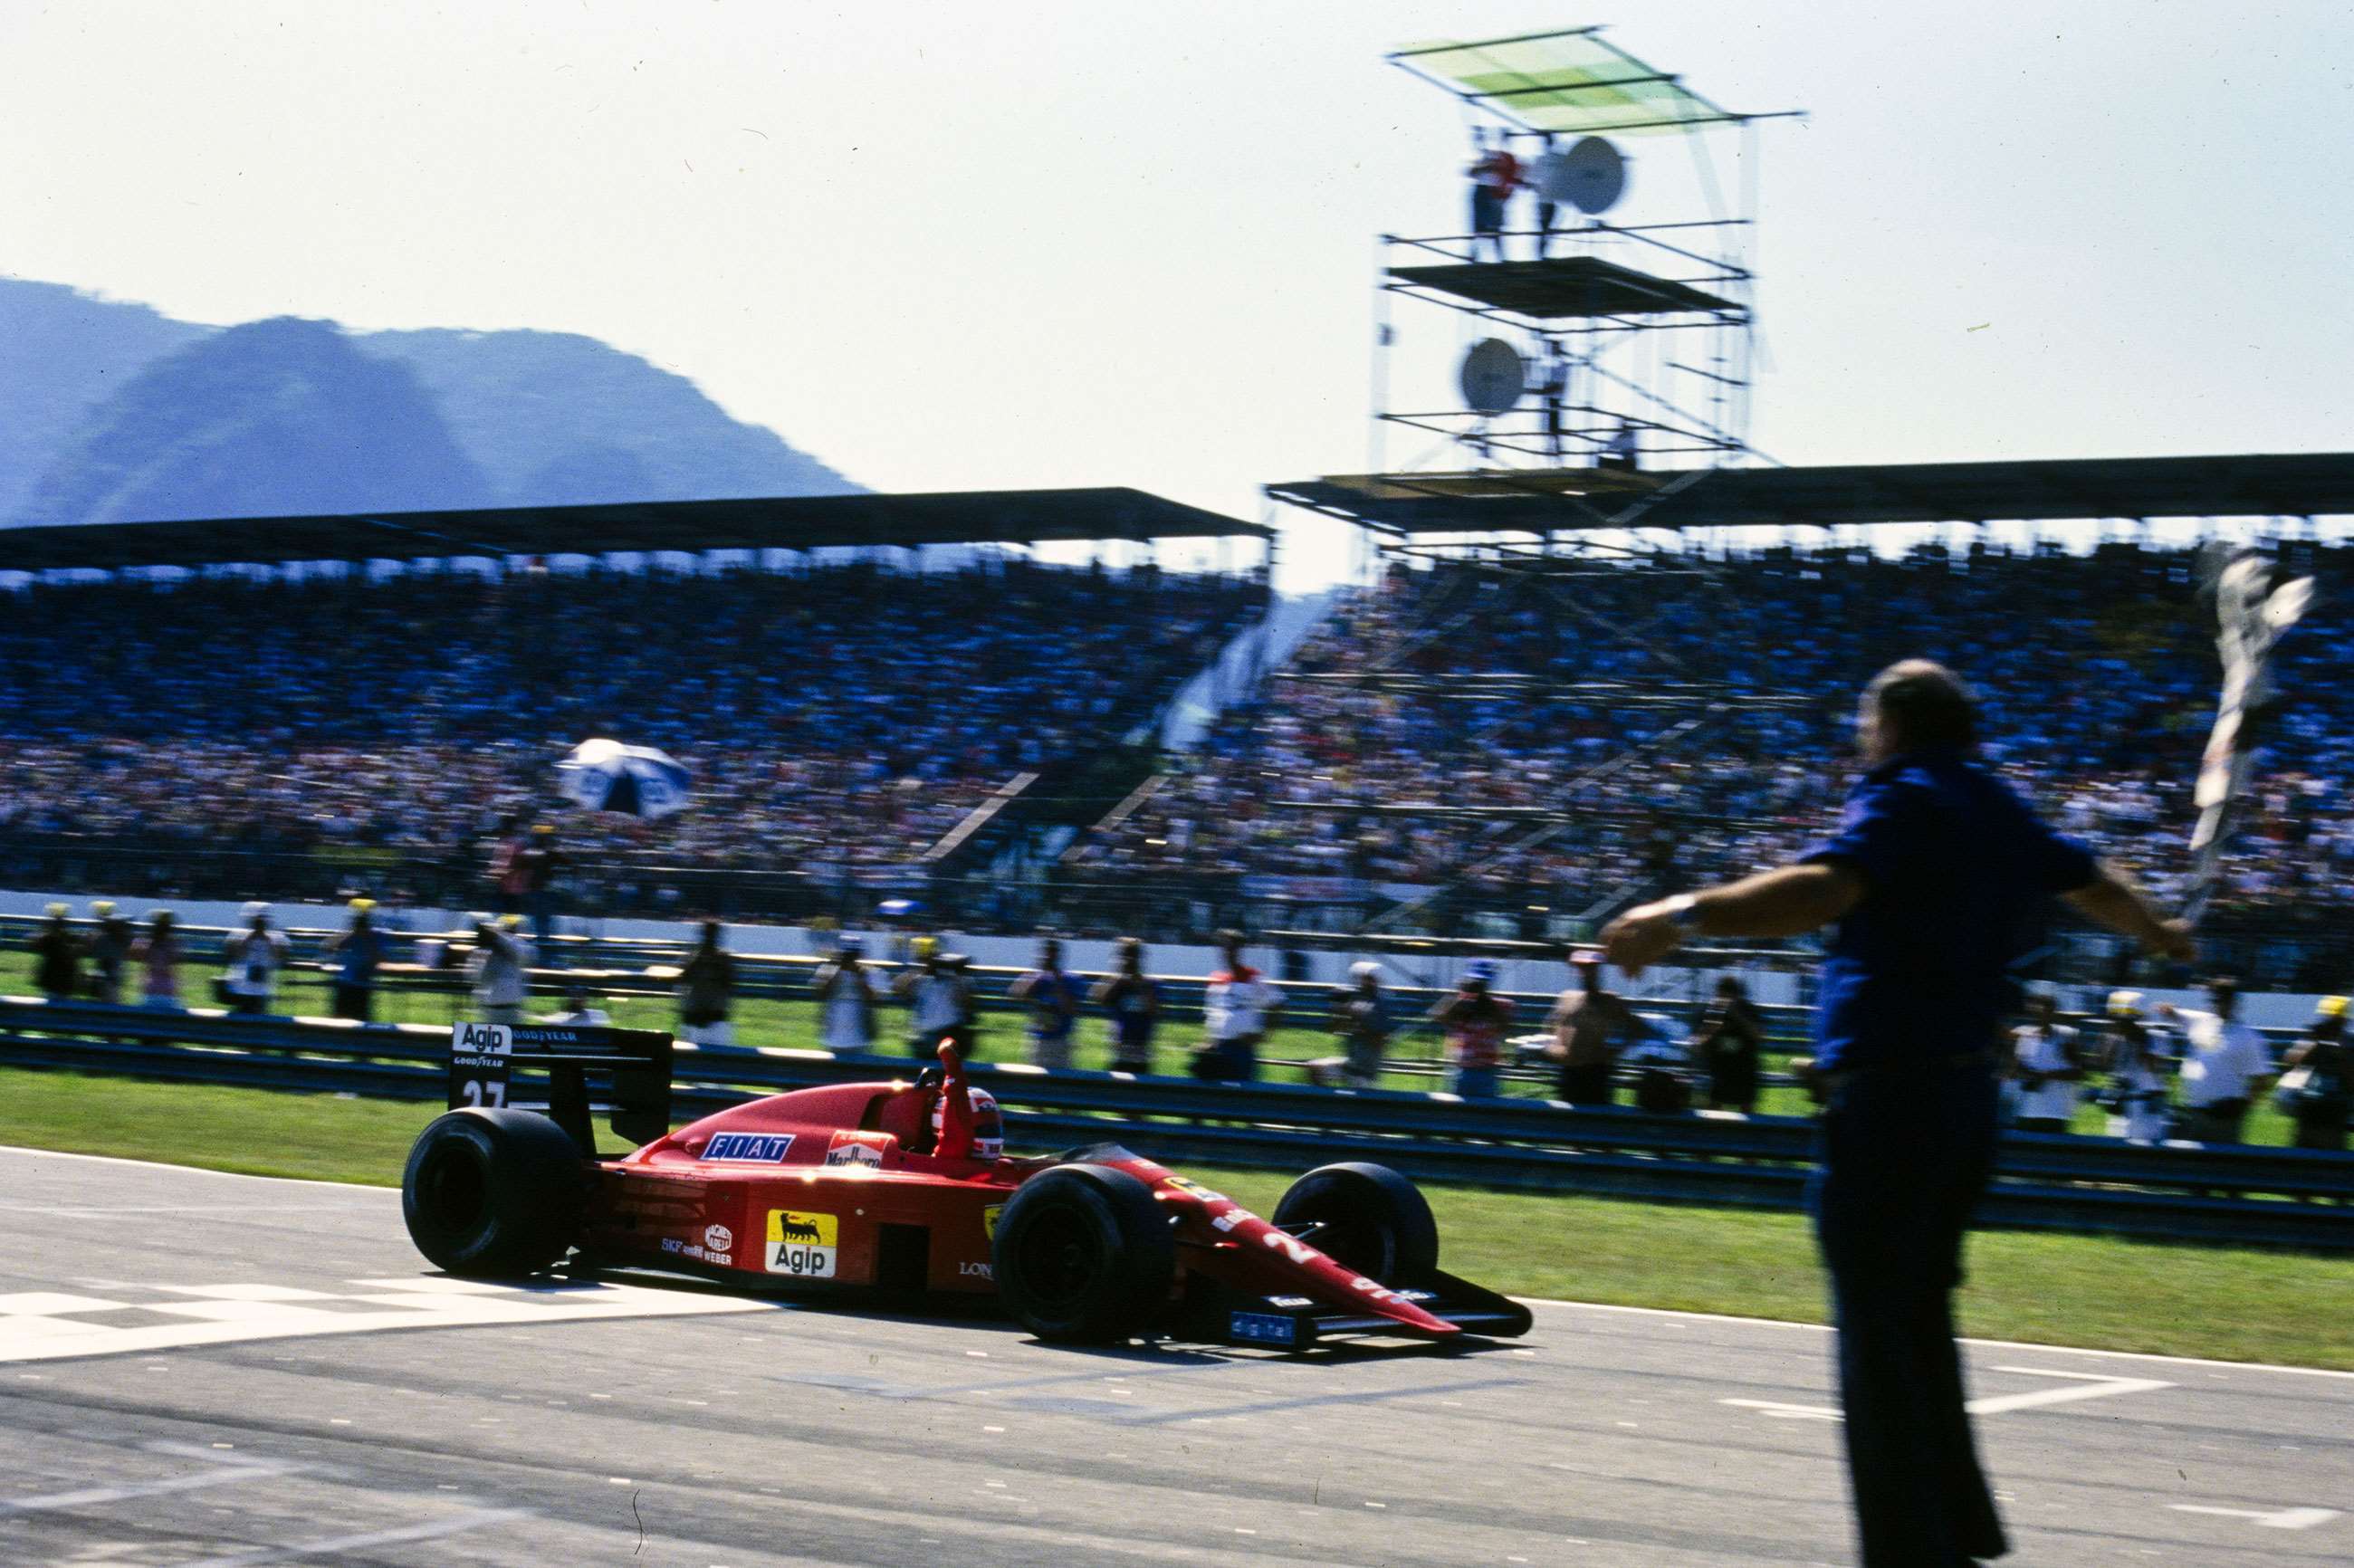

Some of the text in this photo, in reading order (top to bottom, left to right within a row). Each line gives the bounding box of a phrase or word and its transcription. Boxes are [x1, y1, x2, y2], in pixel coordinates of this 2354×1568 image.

[461, 1024, 503, 1052] Agip
[513, 1028, 578, 1041] OODYEAR
[463, 1079, 506, 1107] 27
[711, 1138, 787, 1157] FIAT
[826, 1145, 881, 1169] Marlboro
[662, 1238, 684, 1253] SKF
[704, 1250, 732, 1267] WEBER
[775, 1243, 826, 1275] Agip
[959, 1261, 993, 1276] LON
